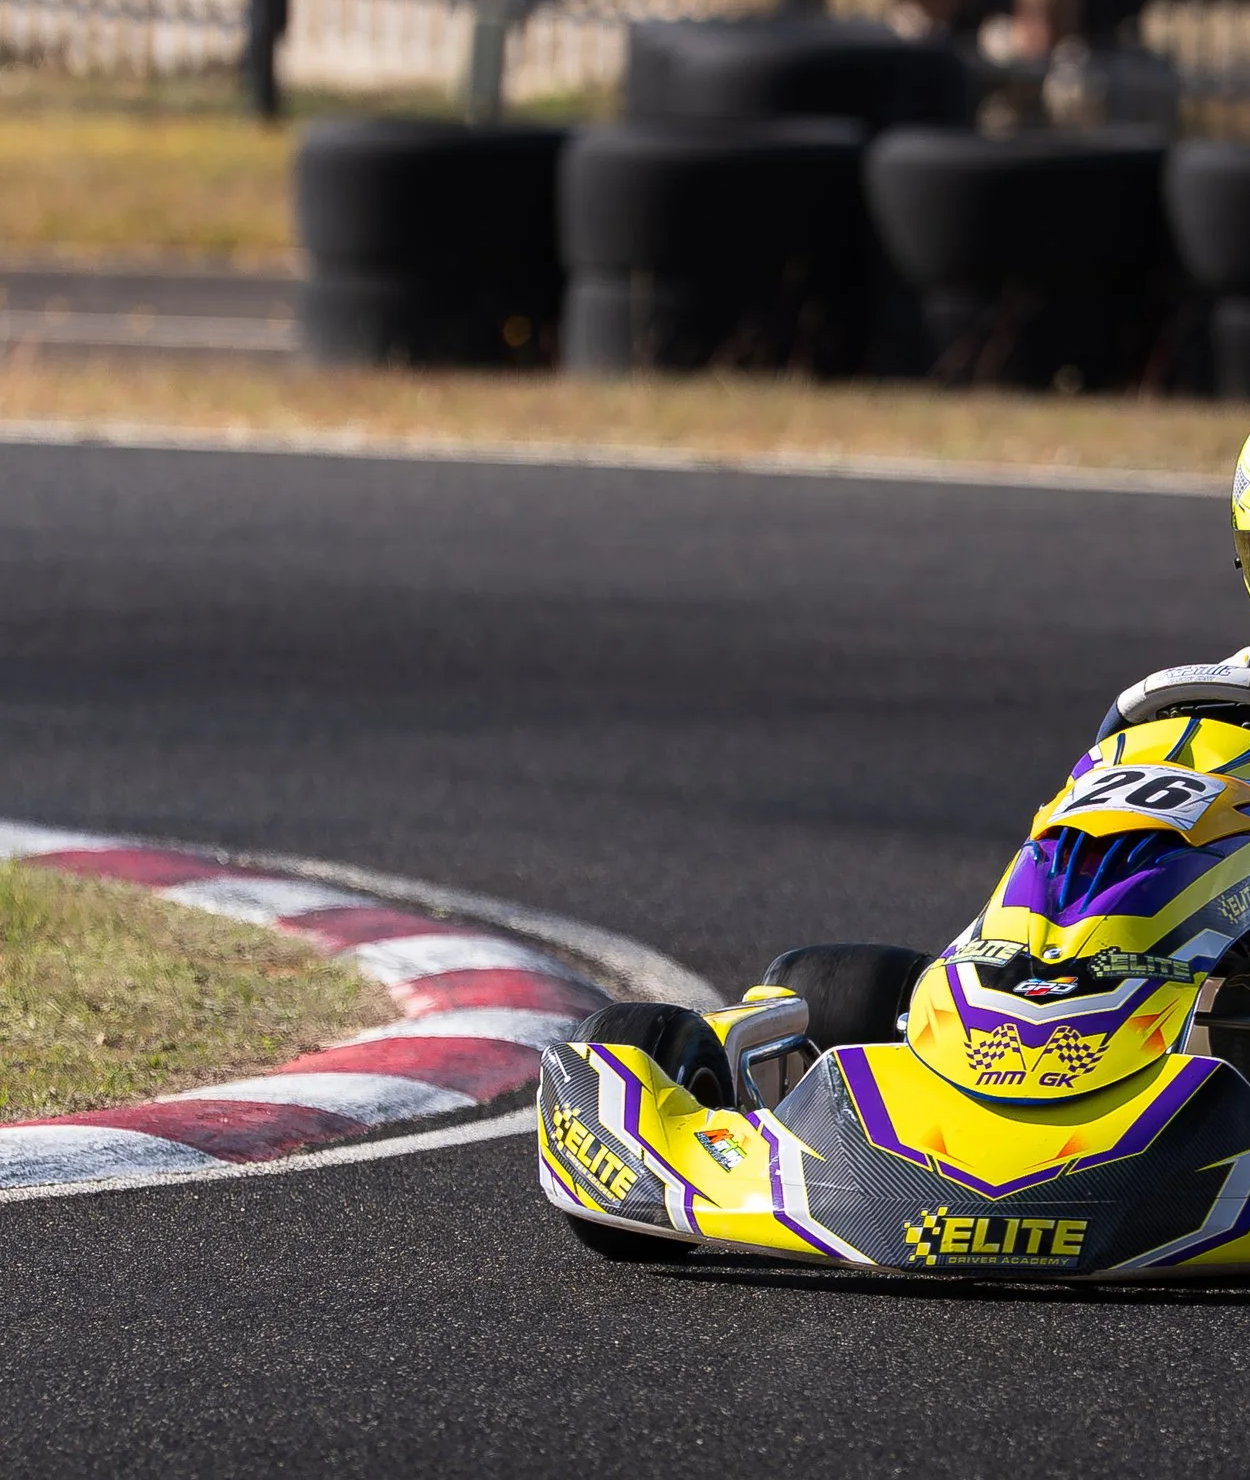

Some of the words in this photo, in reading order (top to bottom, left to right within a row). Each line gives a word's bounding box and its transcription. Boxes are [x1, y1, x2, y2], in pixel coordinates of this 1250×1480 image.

[1063, 770, 1206, 813] 26
[1110, 953, 1192, 977] ELITE
[1039, 1072, 1080, 1088] GK
[564, 1119, 640, 1201] ELITE
[939, 1217, 1088, 1255] ELITE
[948, 1256, 1000, 1265] DRIVER
[1001, 1256, 1071, 1265] ACADEMY
